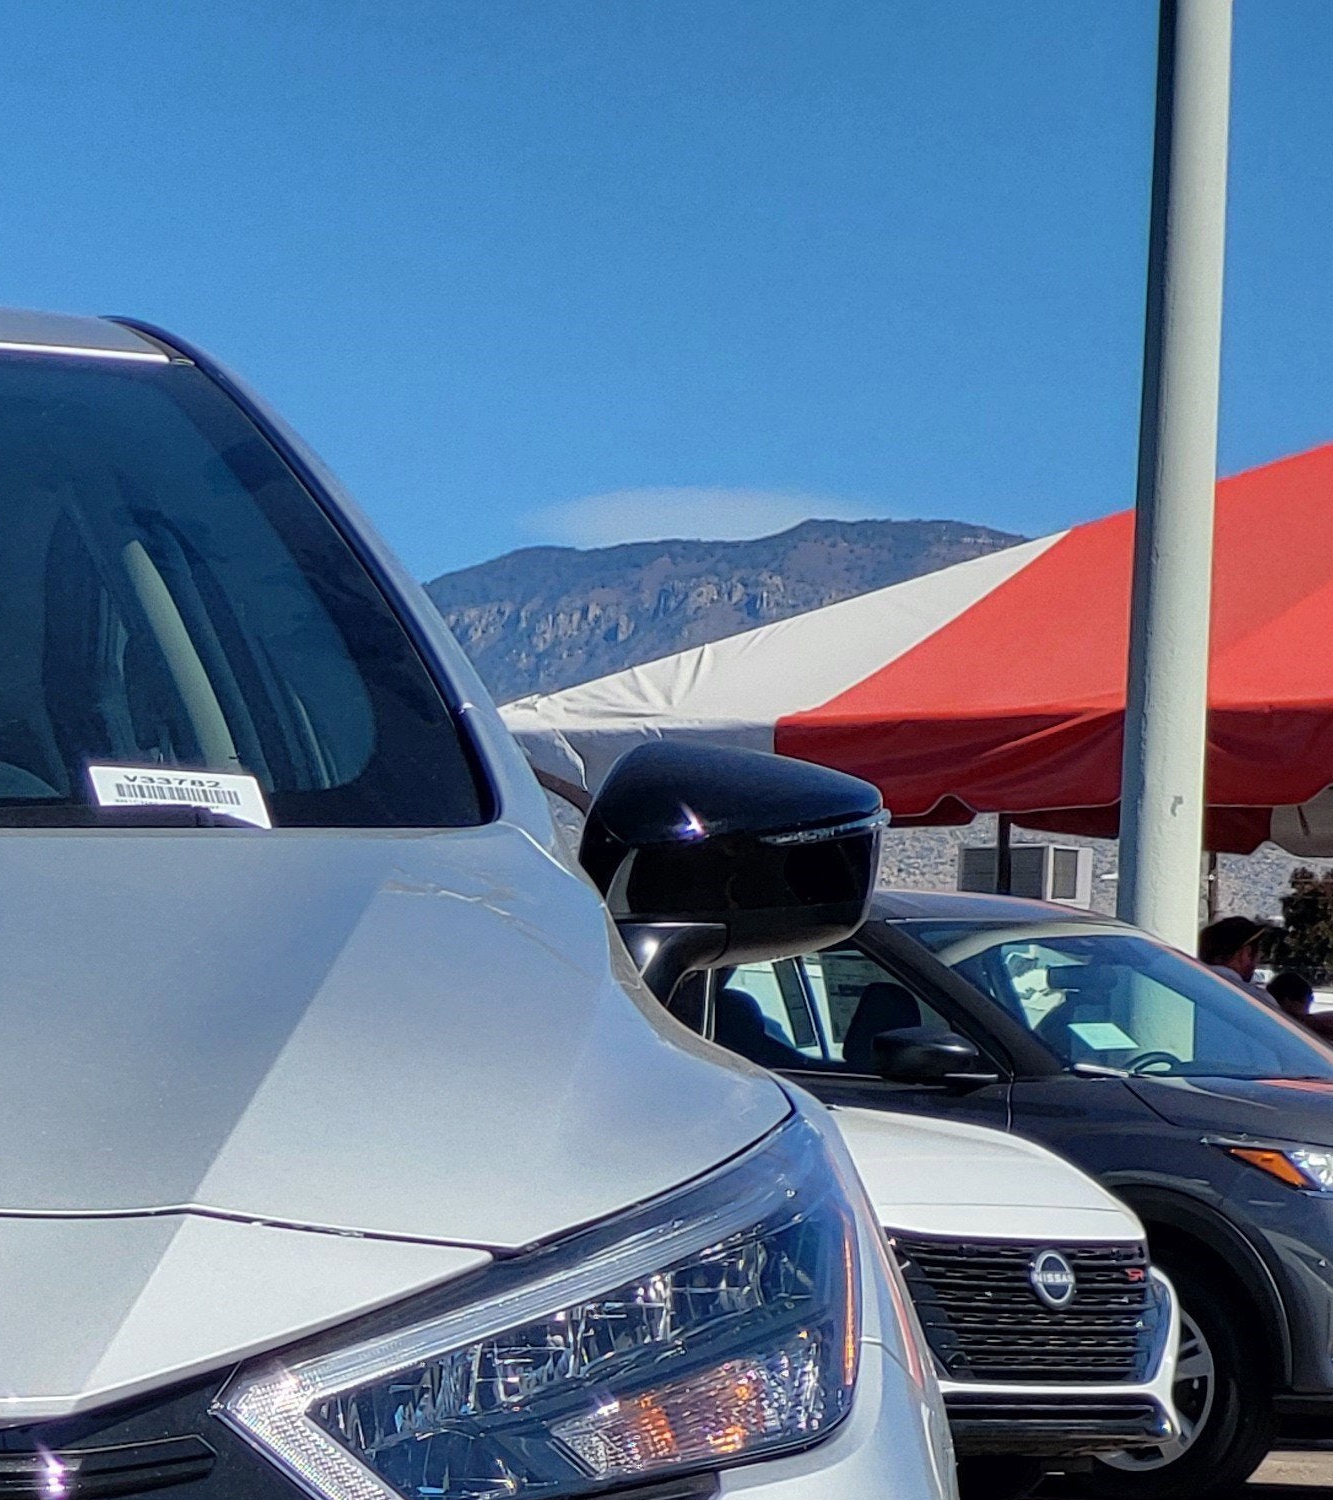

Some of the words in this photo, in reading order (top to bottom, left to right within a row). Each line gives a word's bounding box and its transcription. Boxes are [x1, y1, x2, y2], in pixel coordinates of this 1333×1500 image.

[123, 775, 222, 788] V33782
[1035, 1272, 1075, 1282] NISSAN
[1125, 1268, 1144, 1281] SR
